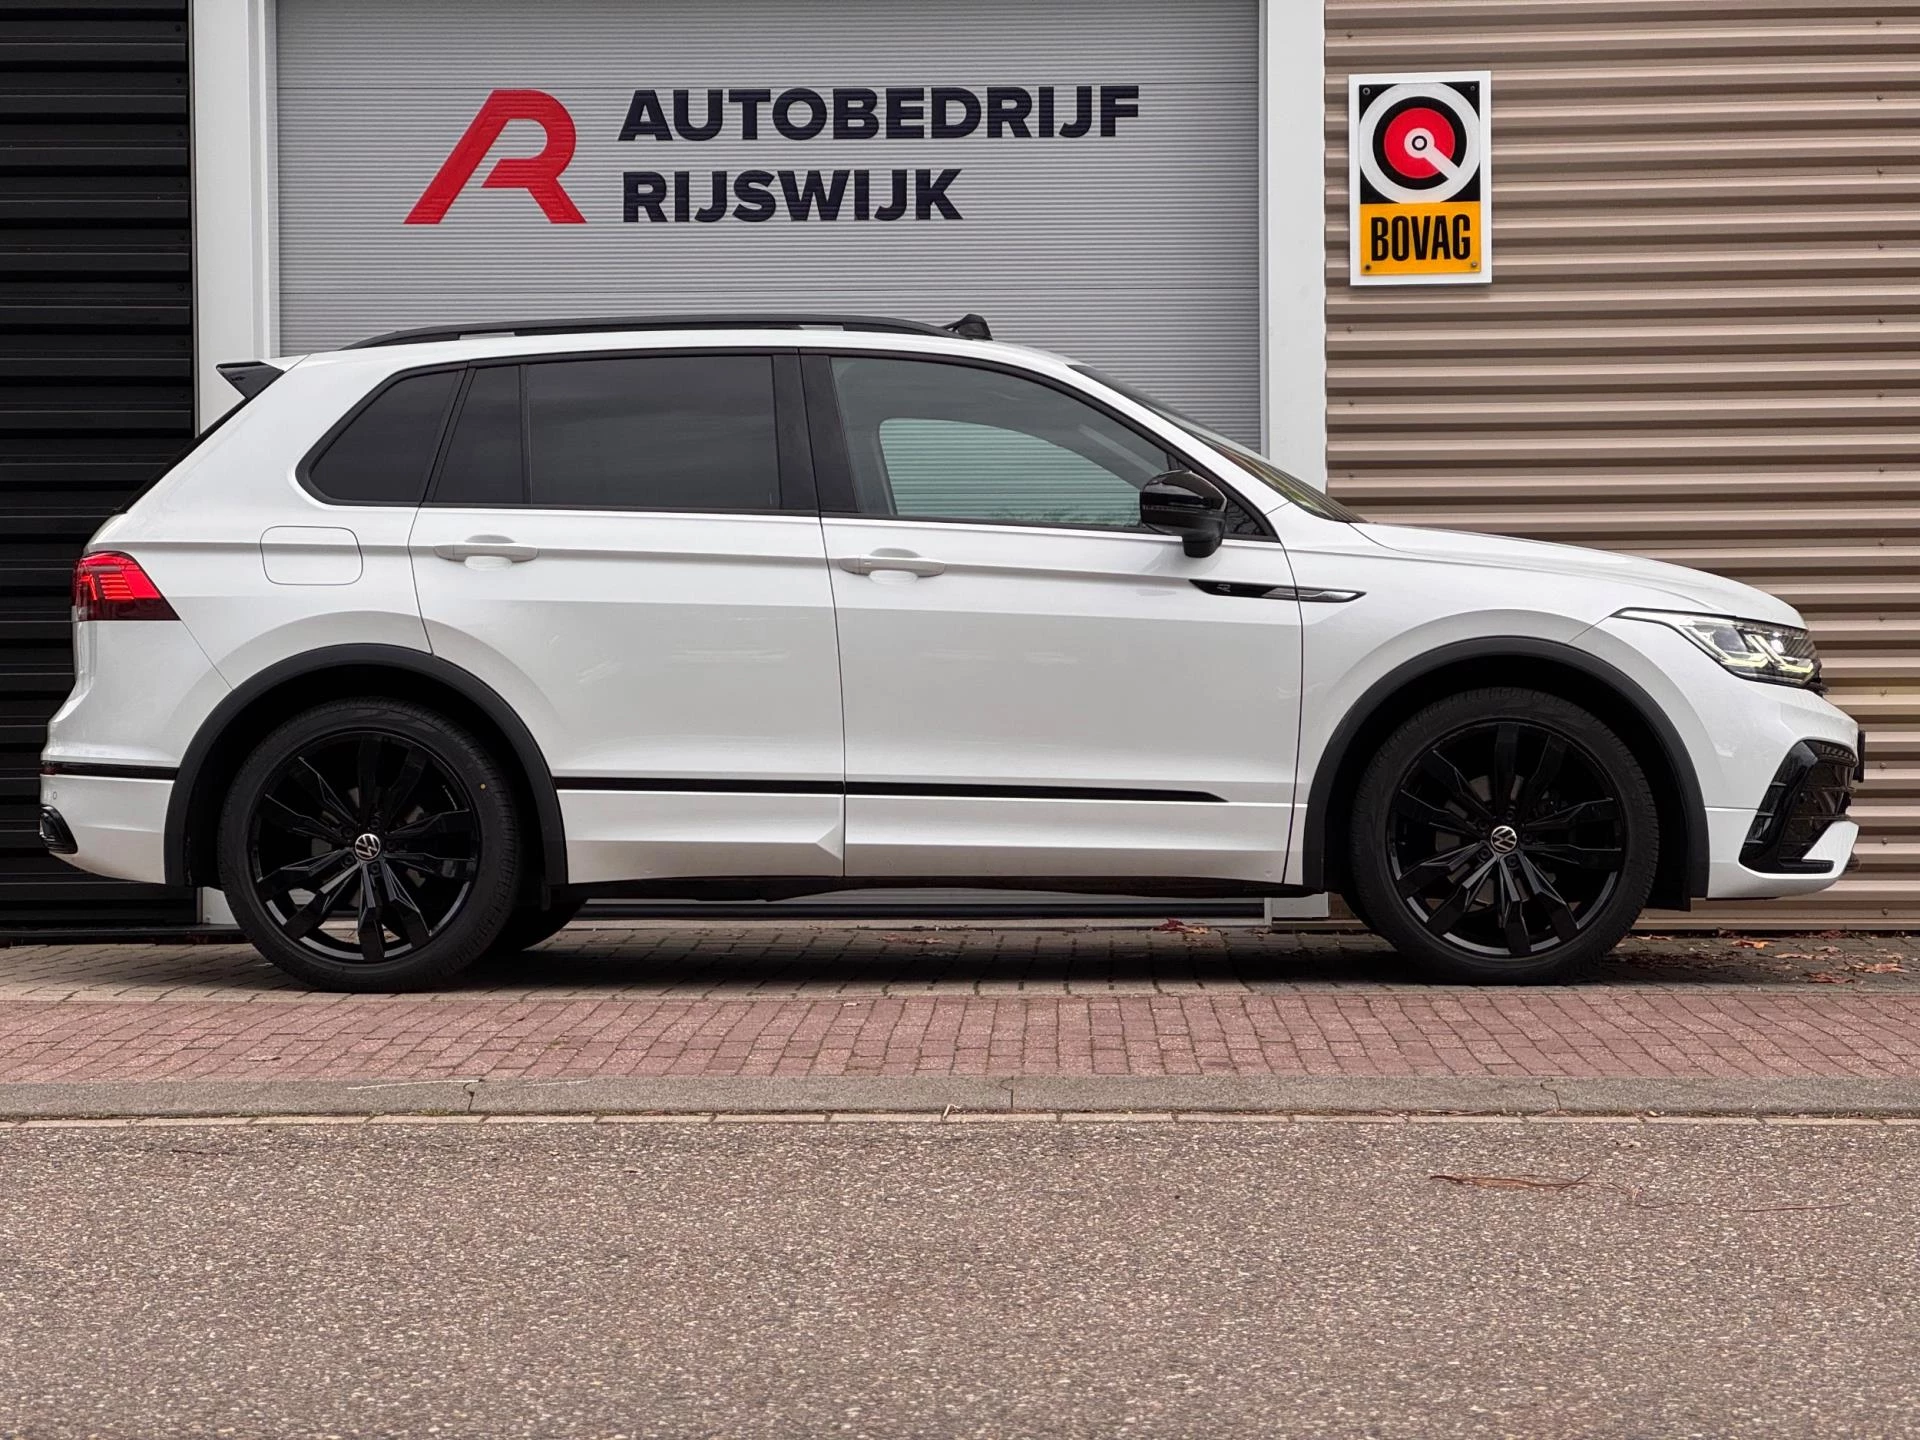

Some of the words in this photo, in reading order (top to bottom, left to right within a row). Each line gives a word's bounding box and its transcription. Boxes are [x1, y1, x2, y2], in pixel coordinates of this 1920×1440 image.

[618, 85, 1139, 141] AUTOBEDRIJF
[622, 169, 963, 223] RIJSWIJK
[1371, 214, 1471, 262] BOVAG
